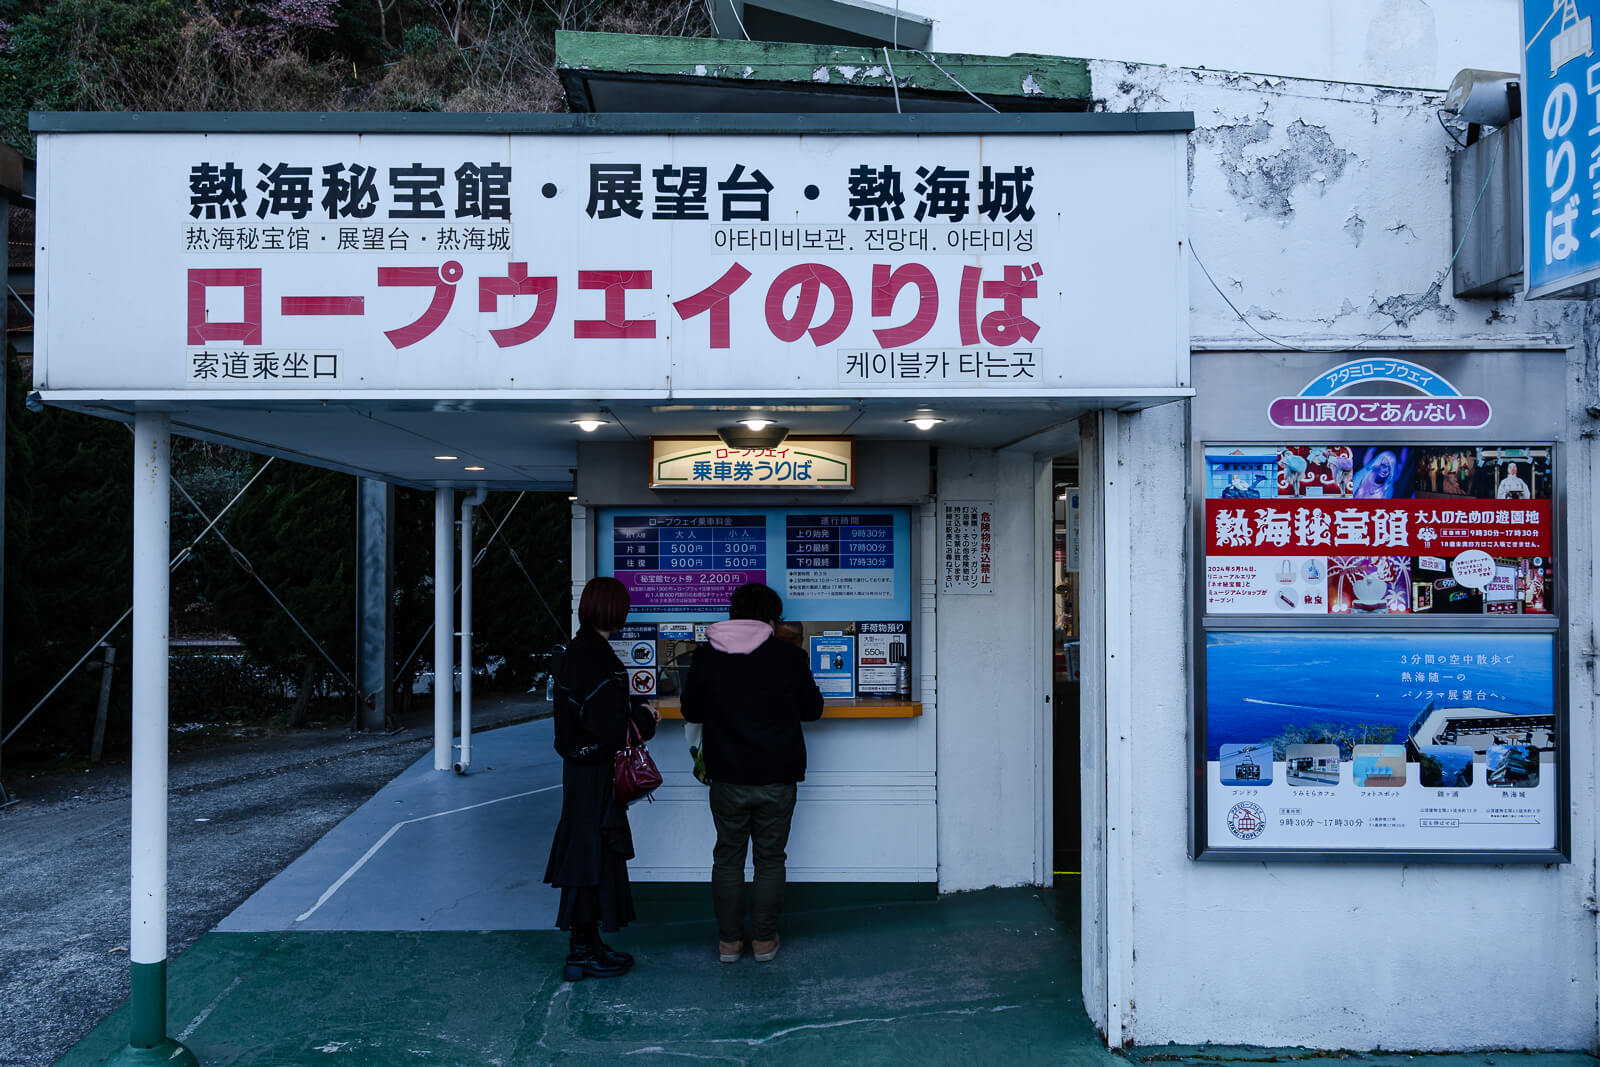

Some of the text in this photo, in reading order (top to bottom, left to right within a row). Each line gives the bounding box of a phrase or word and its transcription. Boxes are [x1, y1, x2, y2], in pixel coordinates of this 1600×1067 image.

[1543, 82, 1579, 264] のりば
[947, 227, 1034, 252] 아타미성
[192, 351, 338, 380] 索道乘坐口
[845, 351, 1037, 379] 케이블카 타는곳
[1294, 401, 1467, 423] 山頂のごあんない
[693, 460, 813, 482] 乗車券うりば
[796, 528, 886, 539] 上り始発 9時30分
[1215, 508, 1540, 547] 熱海秘宝館 大人のための遊園地
[626, 543, 757, 554] 片道 500円 300円
[796, 543, 886, 553] 上り最終 17時00分
[980, 511, 991, 584] 危険物持込禁止
[626, 558, 757, 568] 往復 900円 500円
[796, 557, 886, 567] 下り最終 17時30分
[700, 574, 740, 584] 2,200円
[861, 623, 904, 633] 手荷物預り
[864, 648, 885, 656] 550円
[1401, 671, 1466, 683] 熱海随一の
